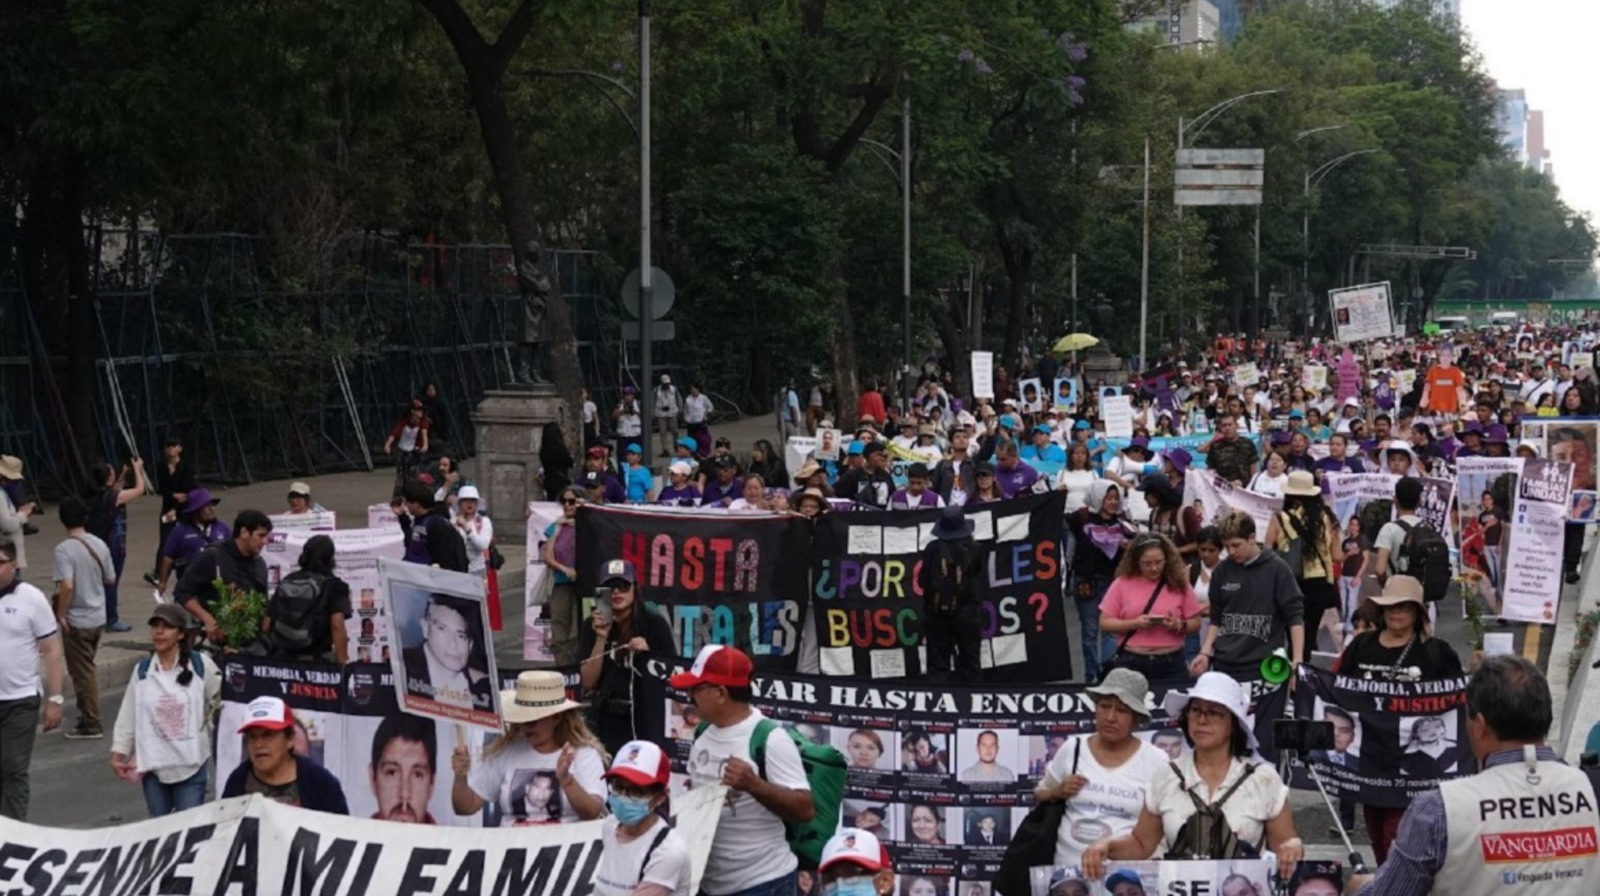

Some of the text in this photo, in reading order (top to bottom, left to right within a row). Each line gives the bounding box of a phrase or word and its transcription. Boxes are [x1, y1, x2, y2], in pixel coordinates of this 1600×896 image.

[621, 531, 759, 592] HASTA
[988, 540, 1057, 589] LES
[280, 682, 288, 694] Y
[1334, 674, 1410, 696] MEMORIA,
[830, 686, 957, 713] HASTA
[1374, 696, 1384, 712] Y
[1479, 790, 1593, 822] PRENSA
[213, 816, 260, 896] A
[281, 826, 384, 896] MI
[1483, 832, 1596, 858] VANGUARDIA
